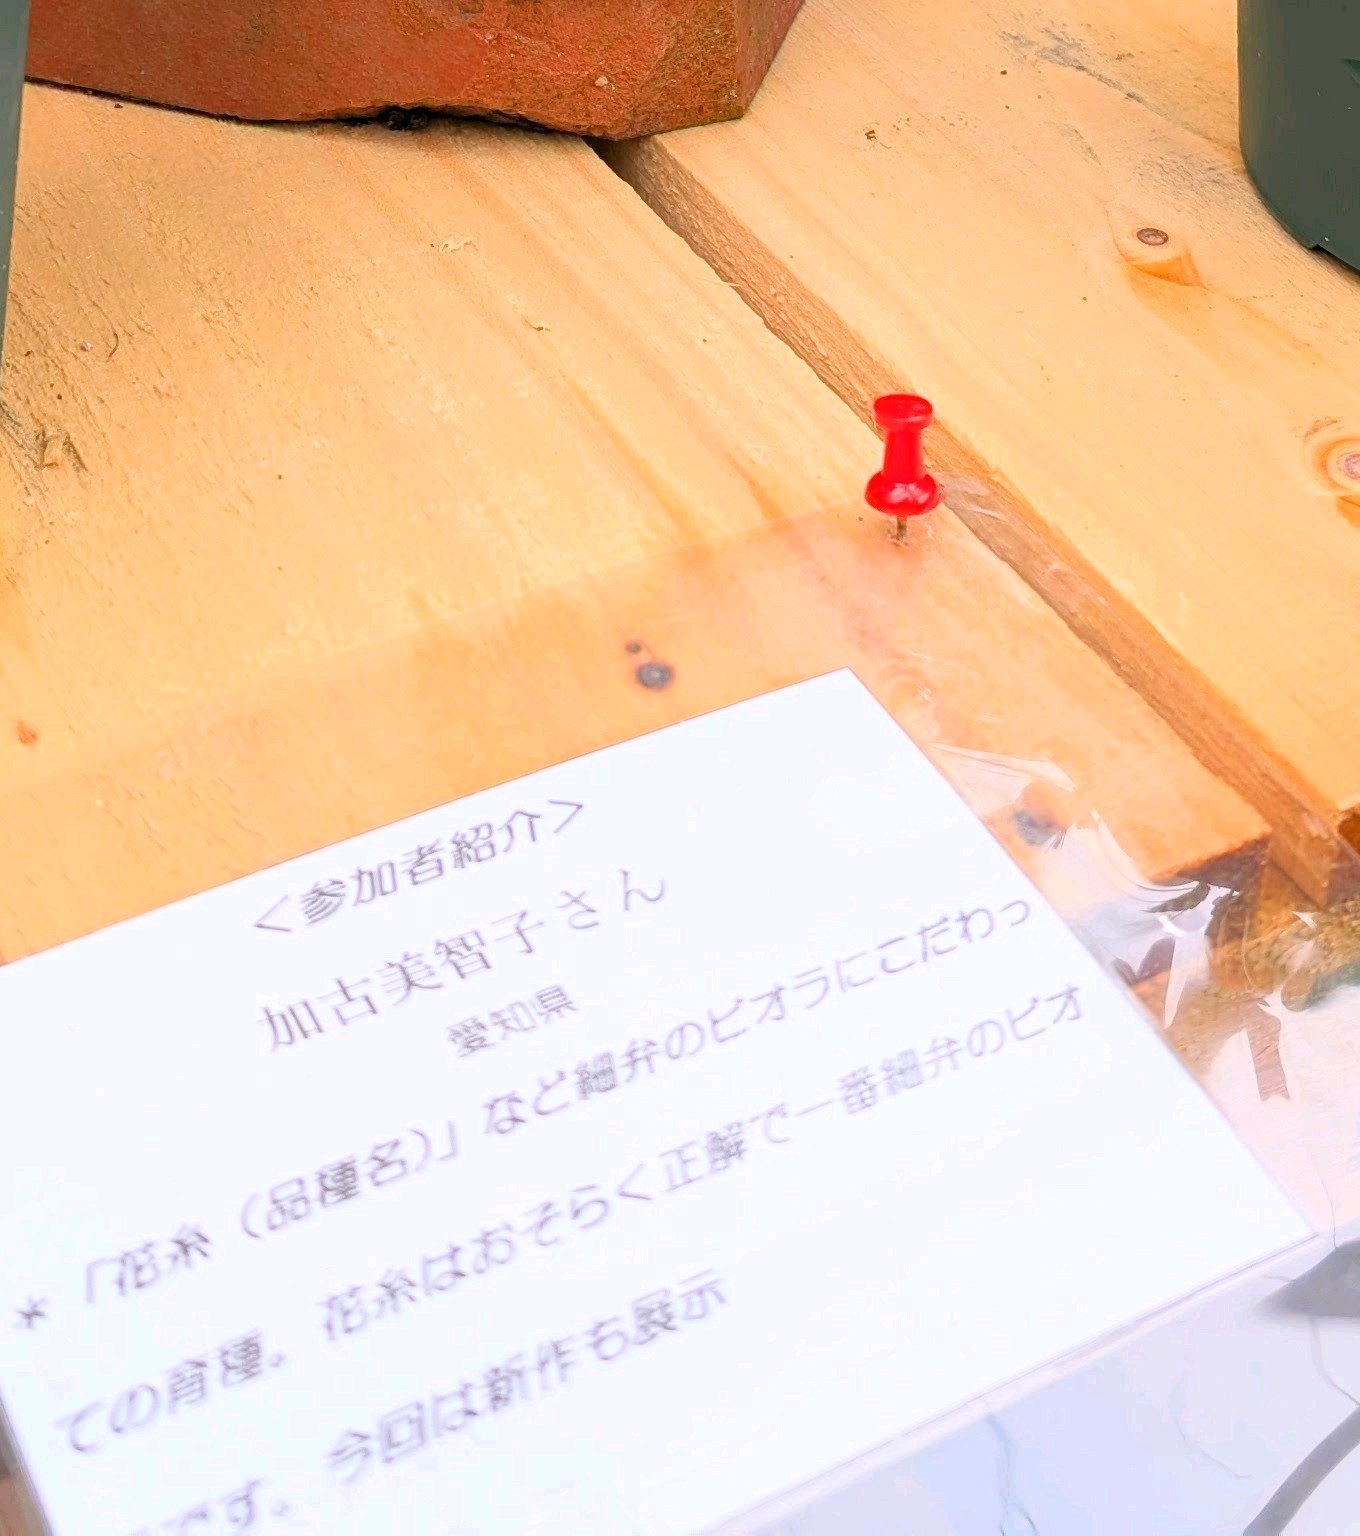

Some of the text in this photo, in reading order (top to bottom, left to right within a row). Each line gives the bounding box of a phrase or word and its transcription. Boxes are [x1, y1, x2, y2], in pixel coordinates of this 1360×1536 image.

[256, 868, 667, 1051] 加古美智子さん
[445, 985, 578, 1058] 愛知県
